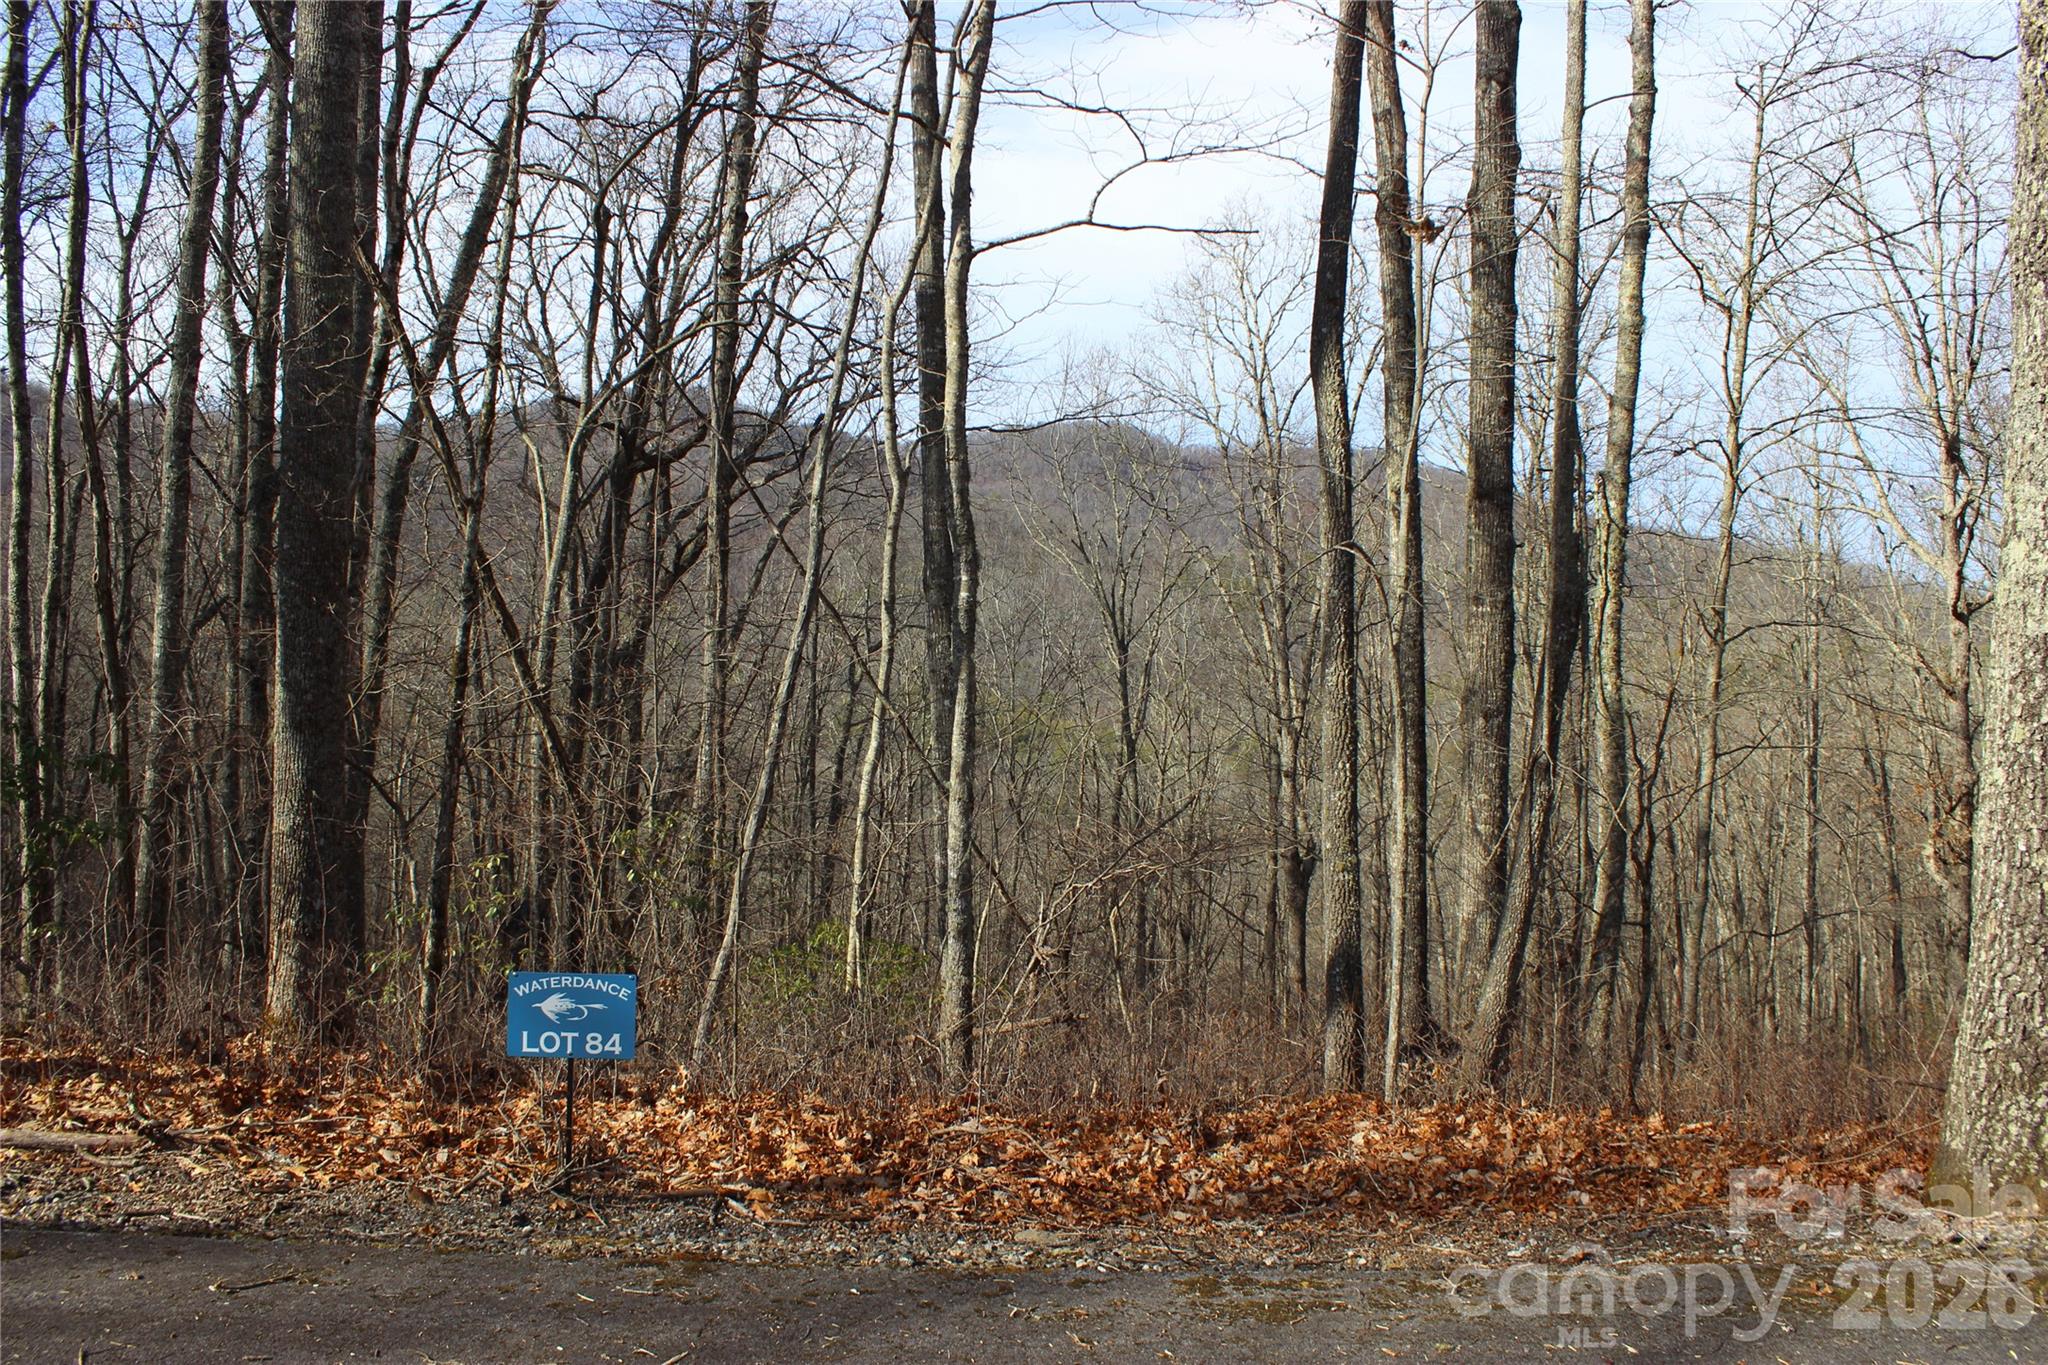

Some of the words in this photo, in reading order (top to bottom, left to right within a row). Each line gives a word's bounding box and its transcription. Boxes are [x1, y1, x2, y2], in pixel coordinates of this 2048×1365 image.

[513, 976, 632, 1001] WATERDANCE
[521, 1030, 580, 1054] LOT
[584, 1032, 623, 1056] 84
